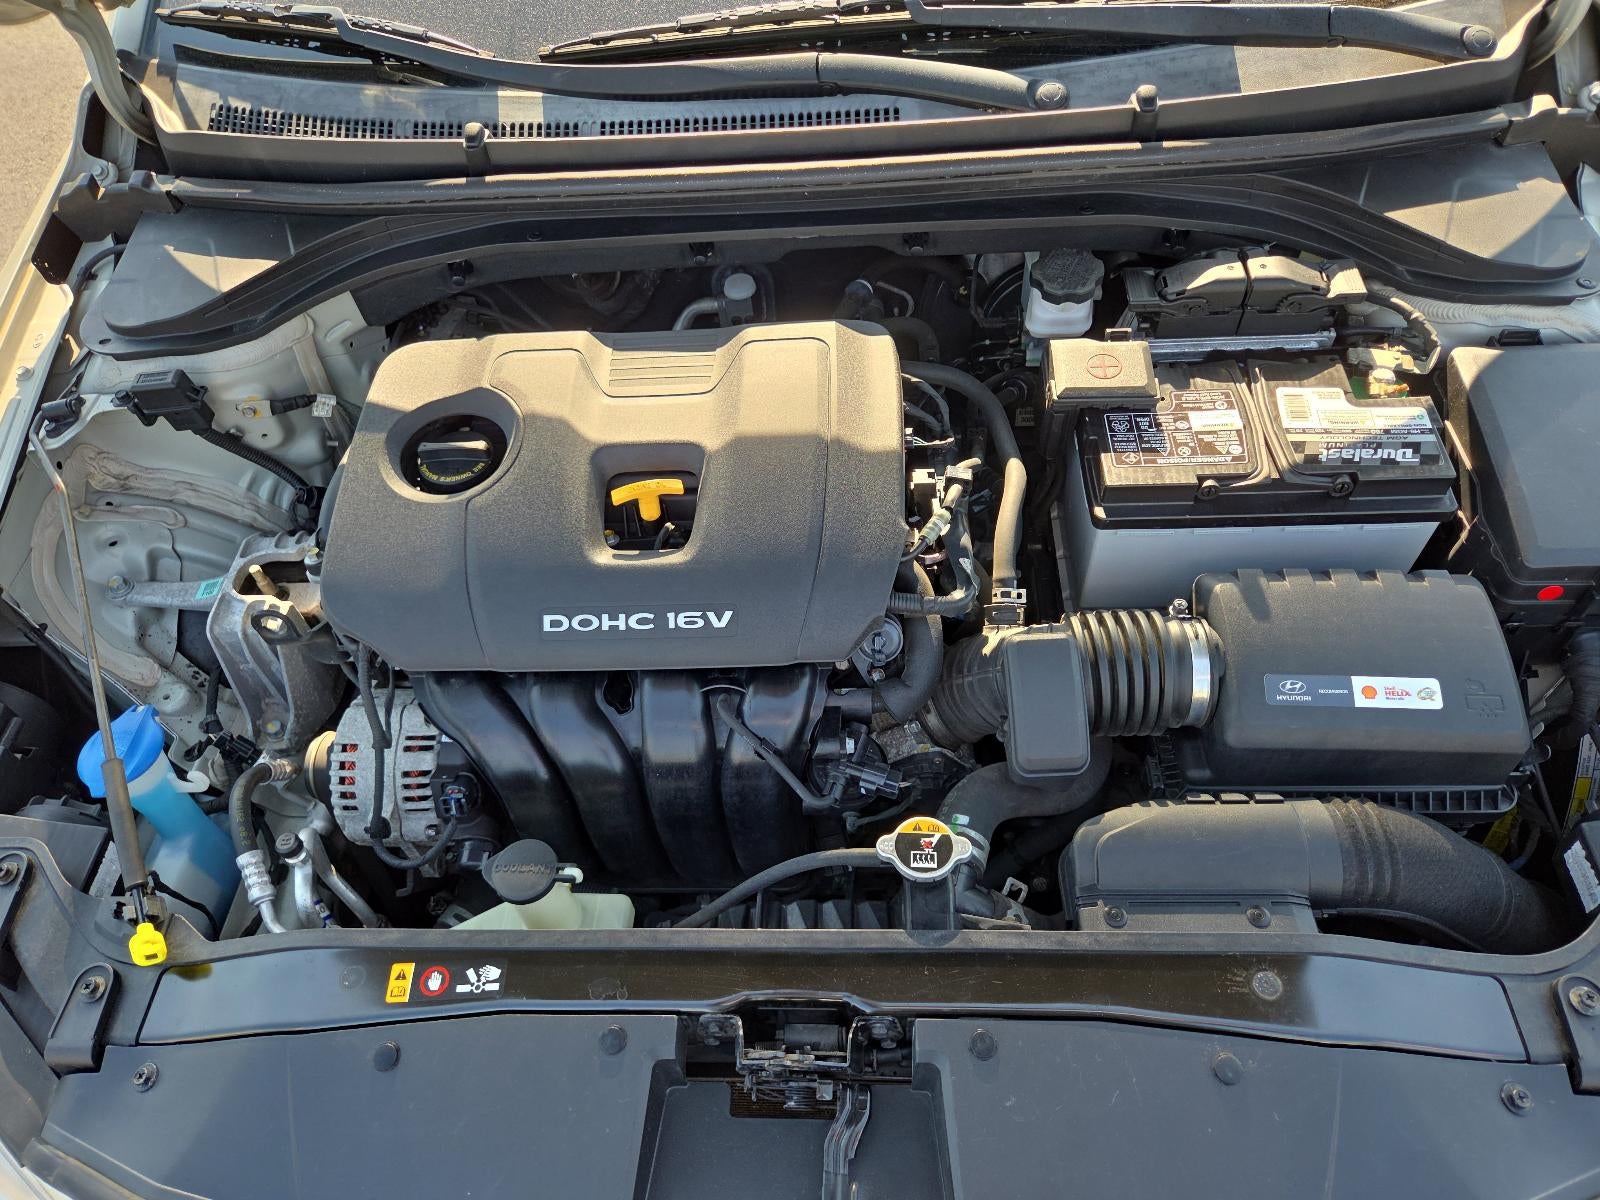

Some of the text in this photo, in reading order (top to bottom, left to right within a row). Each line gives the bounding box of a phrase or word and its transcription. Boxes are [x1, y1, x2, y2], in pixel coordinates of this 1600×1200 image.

[1318, 441, 1377, 449] PLATINUM
[1318, 448, 1420, 462] Duralast
[542, 610, 734, 632] DOHC 16V
[1276, 694, 1312, 702] HYUNDAI
